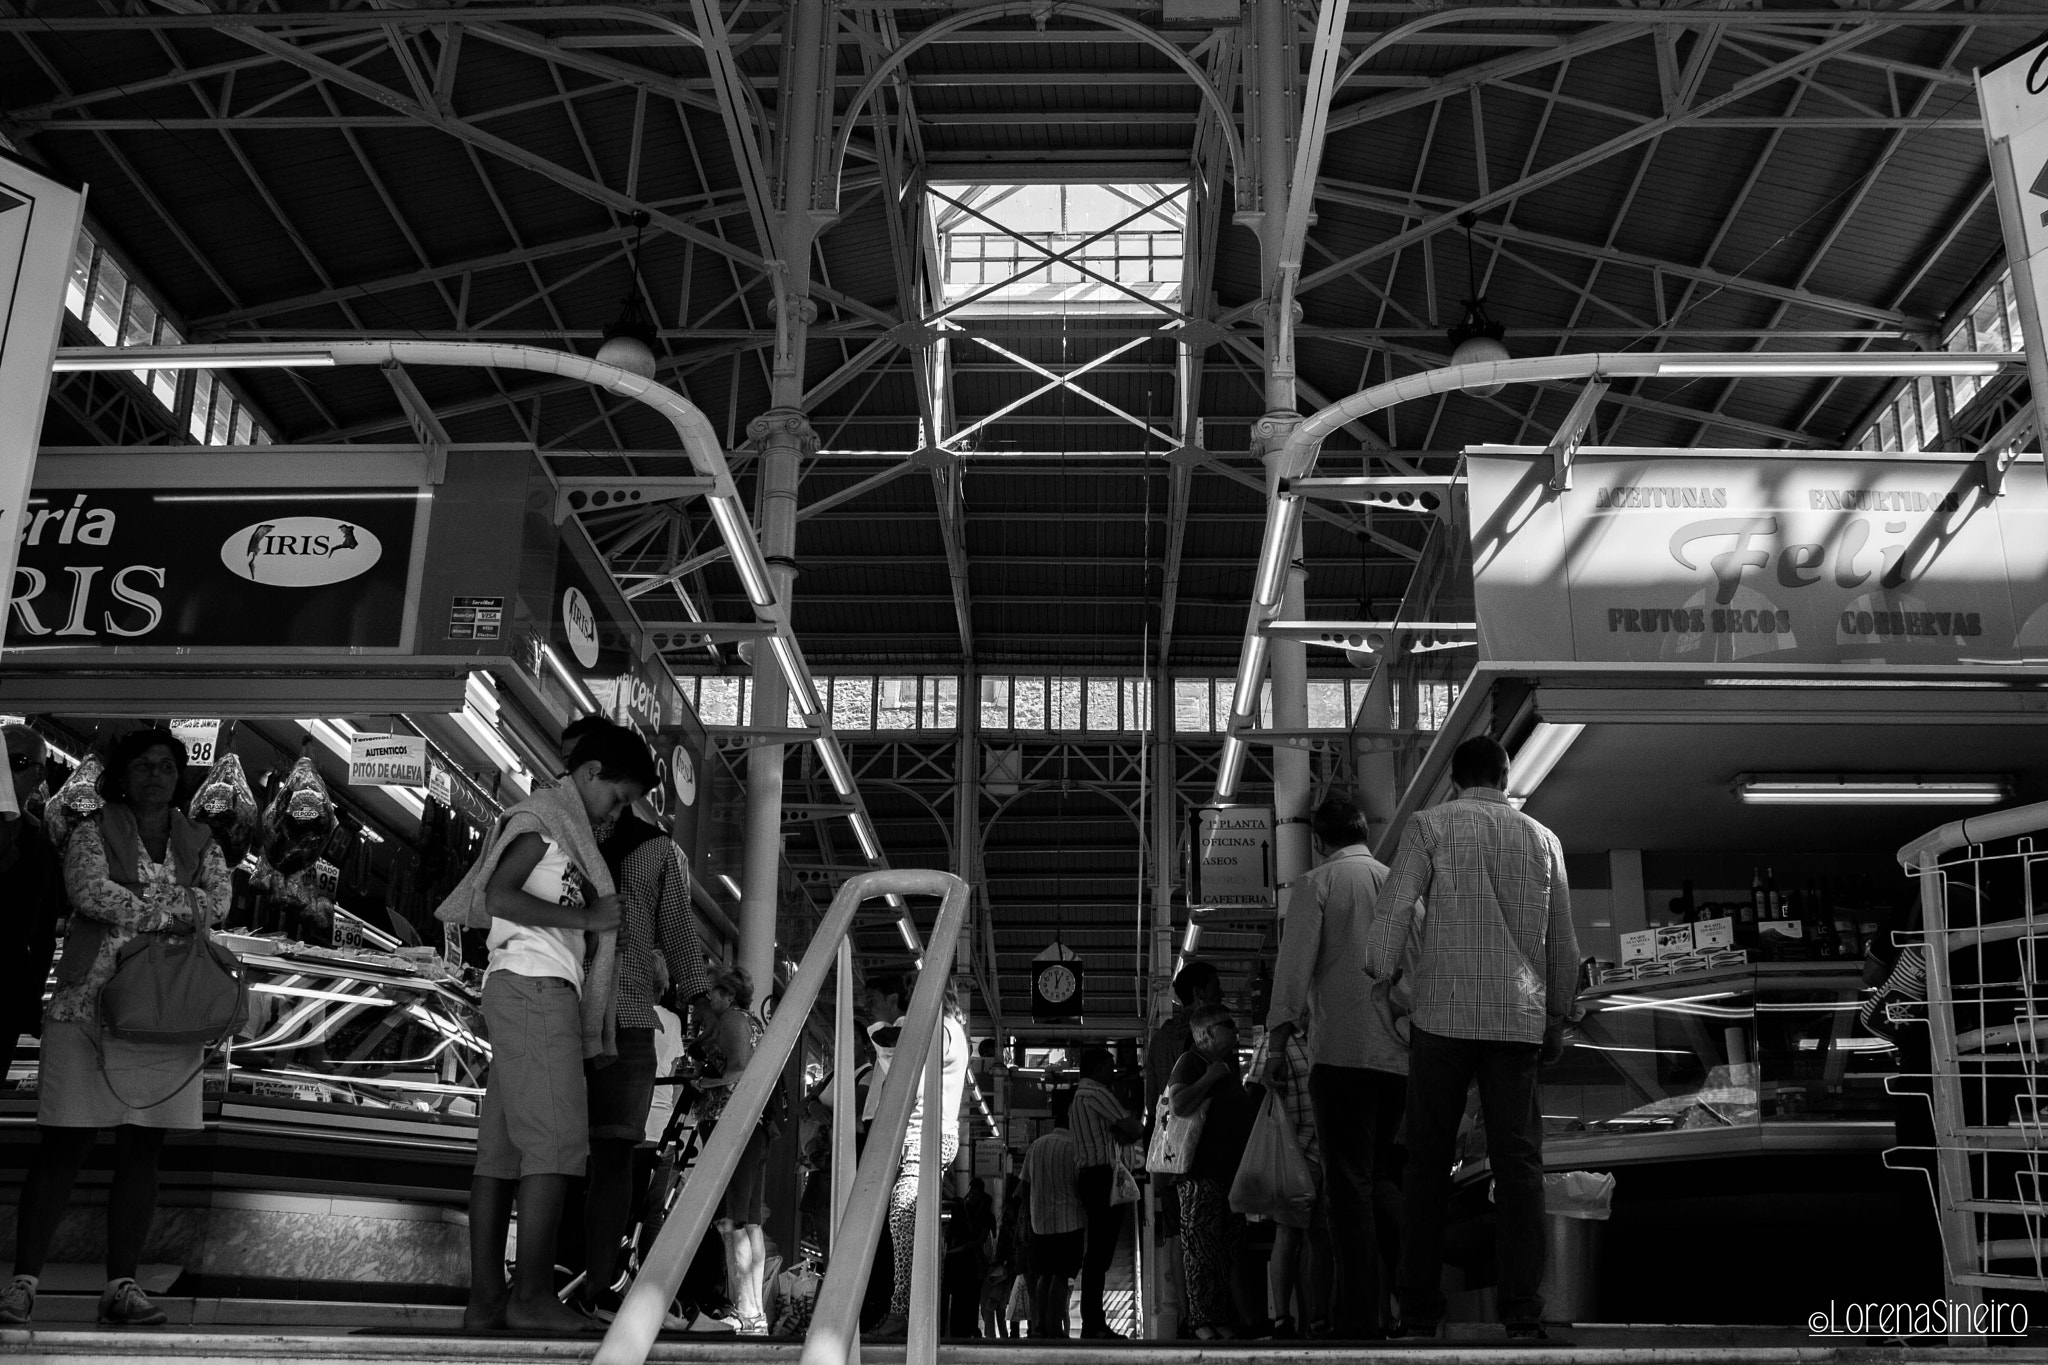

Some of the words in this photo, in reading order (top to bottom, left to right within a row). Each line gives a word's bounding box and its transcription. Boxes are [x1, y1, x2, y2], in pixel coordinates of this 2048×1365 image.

[1596, 487, 1727, 509] ACEITUNAS
[1808, 489, 1959, 512] ENCURTIDOS
[264, 535, 330, 555] IRIS
[1669, 516, 1906, 605] Feli
[572, 602, 589, 639] IRIS
[1608, 608, 1705, 633] FRUTOS
[1711, 608, 1791, 633] SECOS
[1840, 611, 1982, 637] CONSERVAS
[365, 746, 408, 757] AUTENTICOS
[352, 762, 376, 778] PITOS
[377, 763, 390, 778] DE
[390, 764, 423, 781] CALEYA
[1220, 820, 1265, 828] PLANTA
[1202, 838, 1256, 847] OFICINAS
[1202, 857, 1238, 865] ASEOS
[1203, 895, 1267, 904] CAFETERIA
[335, 930, 362, 947] 8,90
